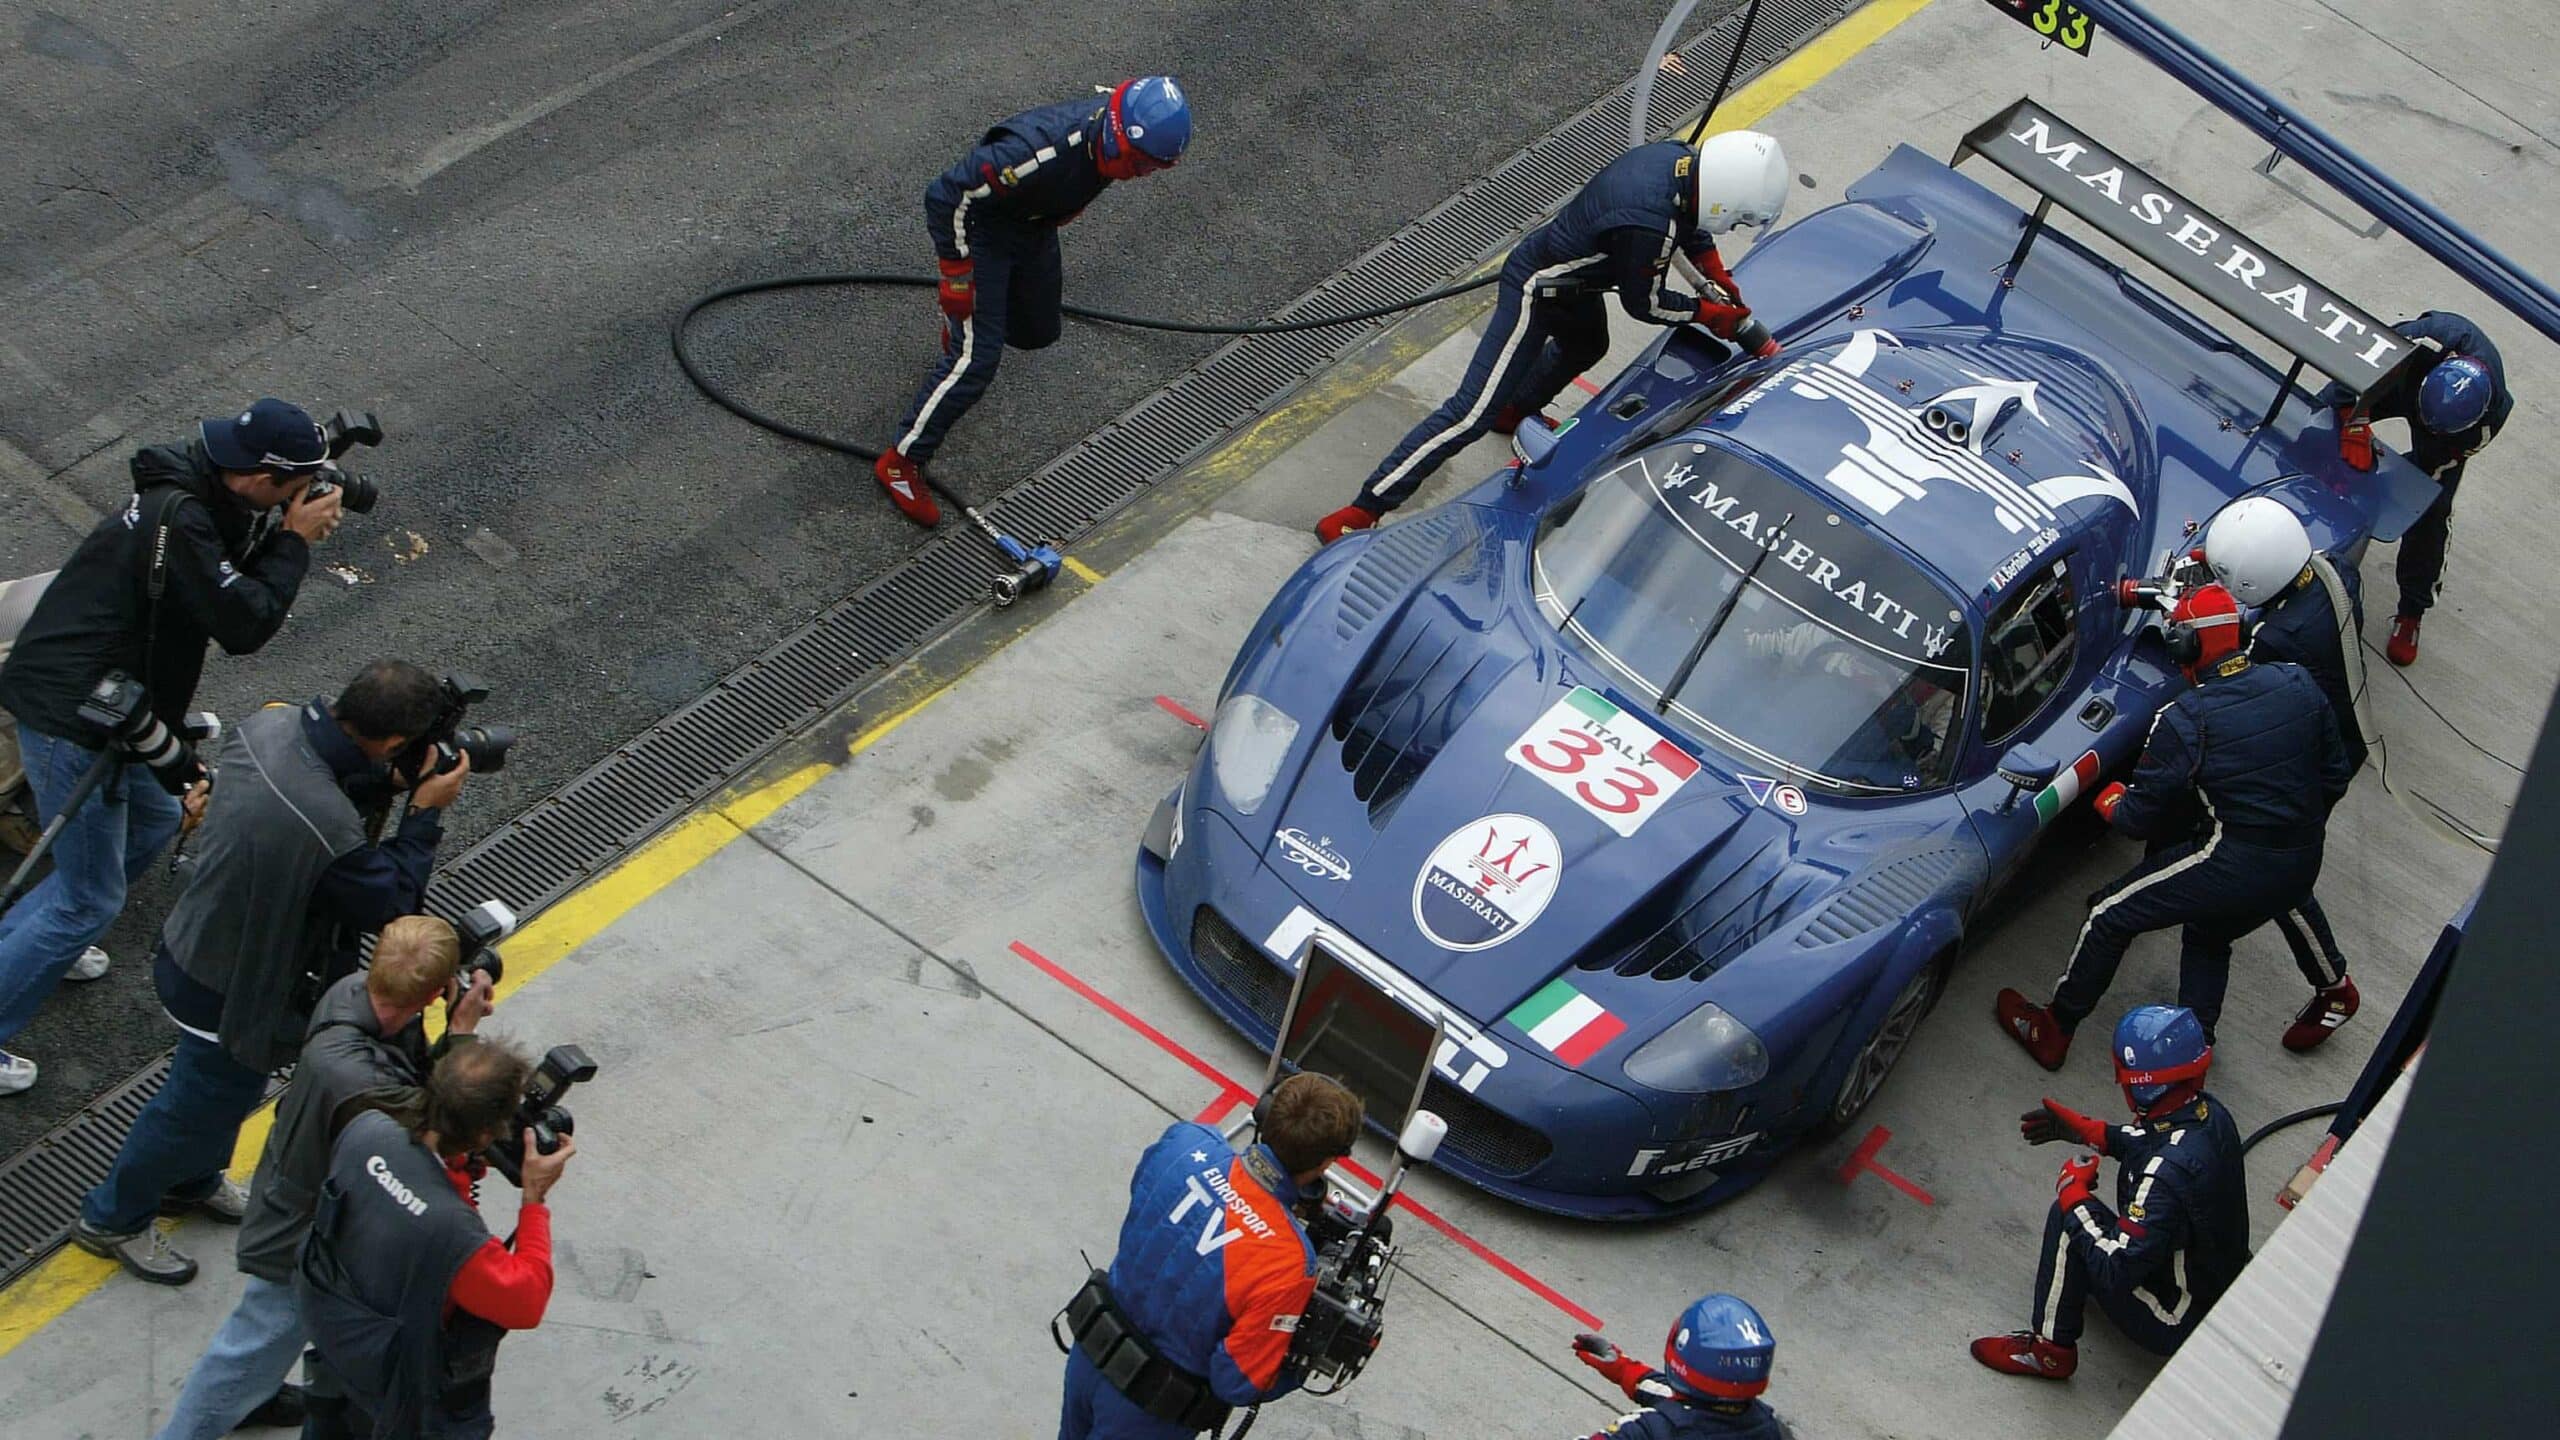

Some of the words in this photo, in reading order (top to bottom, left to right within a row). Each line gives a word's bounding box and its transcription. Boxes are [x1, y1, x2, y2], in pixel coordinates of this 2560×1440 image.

[2033, 0, 2089, 49] 33
[2009, 117, 2397, 369] MASERATI
[1688, 481, 1919, 639] MASERATI
[1520, 728, 1660, 814] 33
[1583, 719, 1656, 767] ITALY
[1783, 793, 1797, 808] E
[1281, 850, 1328, 877] 90
[1298, 834, 1340, 864] MASERATI
[1427, 870, 1512, 932] MASERATI
[366, 1155, 428, 1217] Canon
[1168, 1174, 1244, 1256] TV
[1202, 1166, 1277, 1240] EUROSPORT
